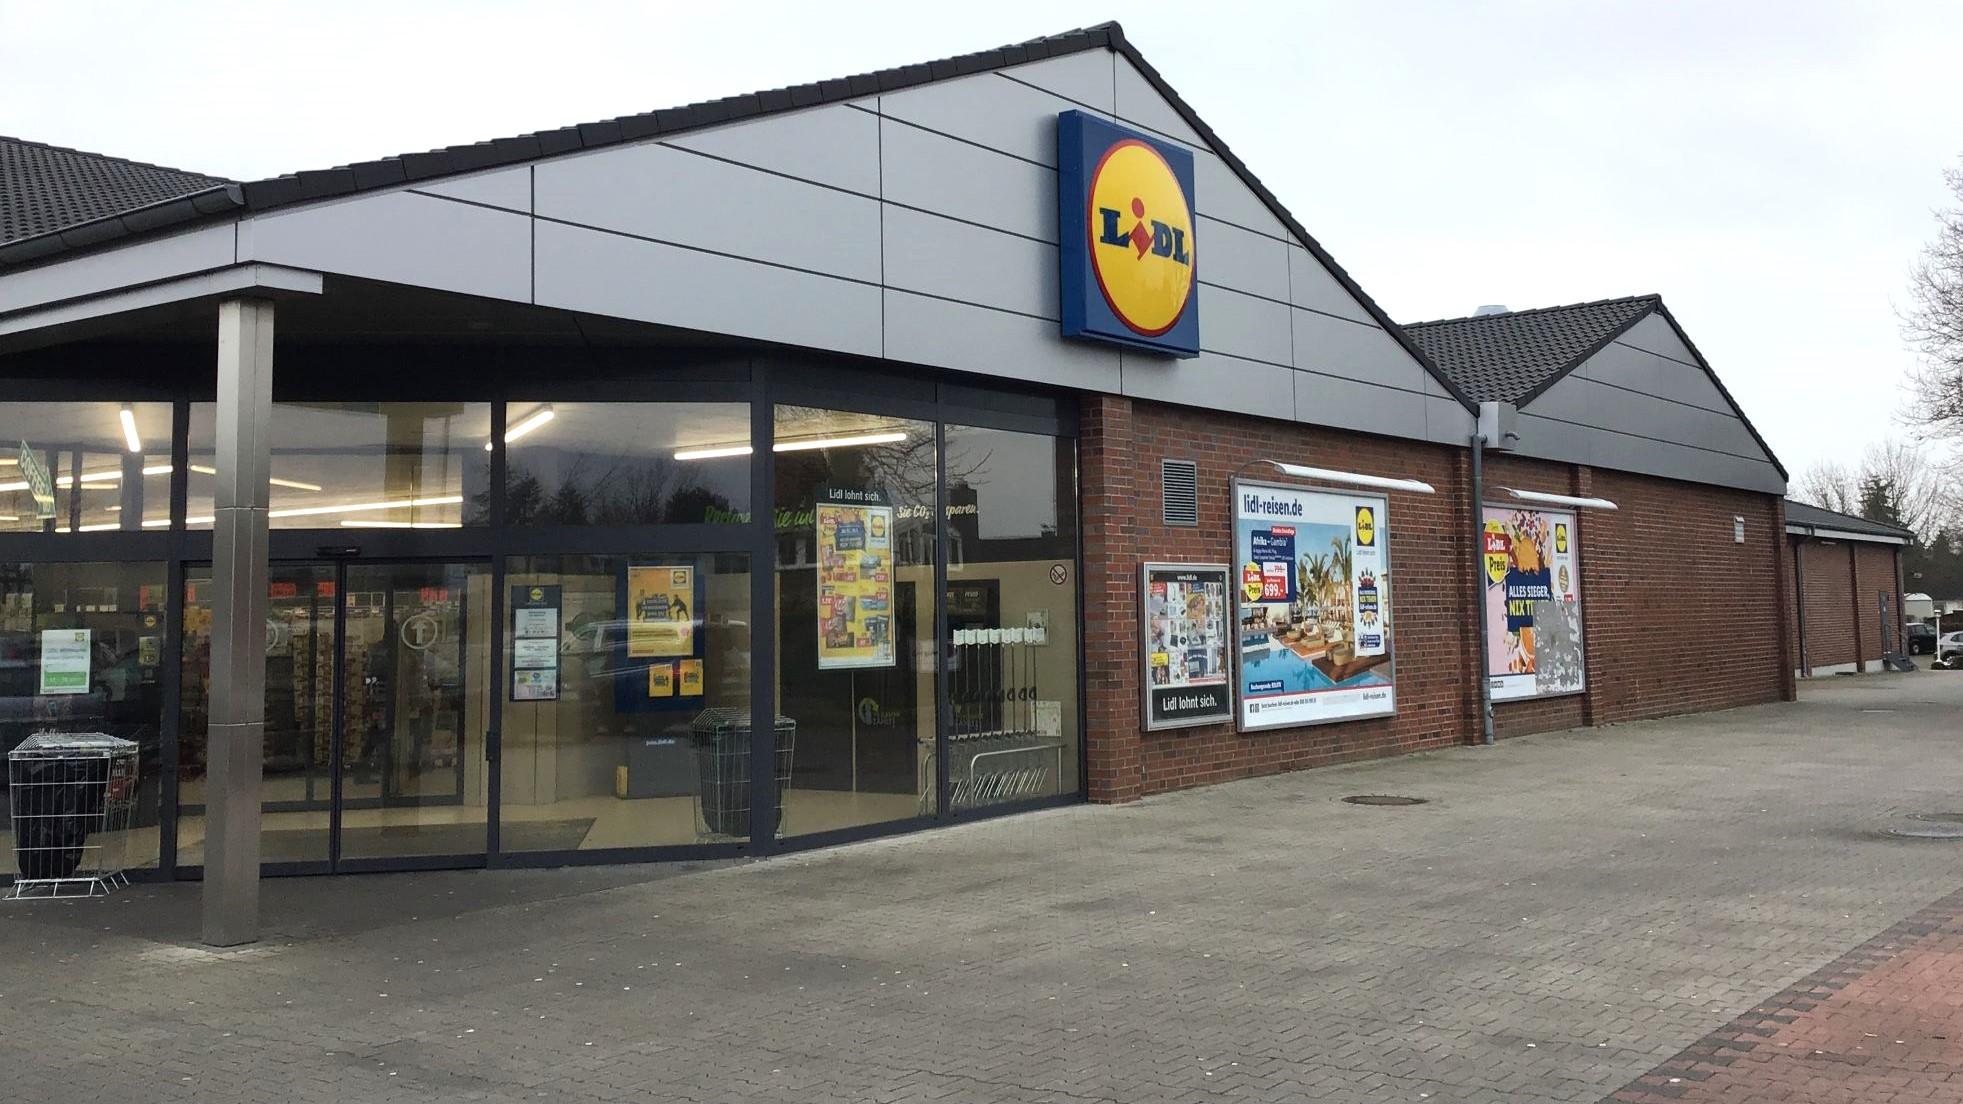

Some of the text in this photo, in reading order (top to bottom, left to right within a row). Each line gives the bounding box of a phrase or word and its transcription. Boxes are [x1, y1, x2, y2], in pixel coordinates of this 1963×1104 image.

[828, 488, 881, 502] Lidl lohnt sich.
[1243, 493, 1303, 516] lidl-reisen.de
[1488, 556, 1506, 573] Preis
[1508, 585, 1527, 598] ALLES
[1509, 599, 1525, 617] NIX
[1162, 693, 1217, 712] Lidl lohnt sich.
